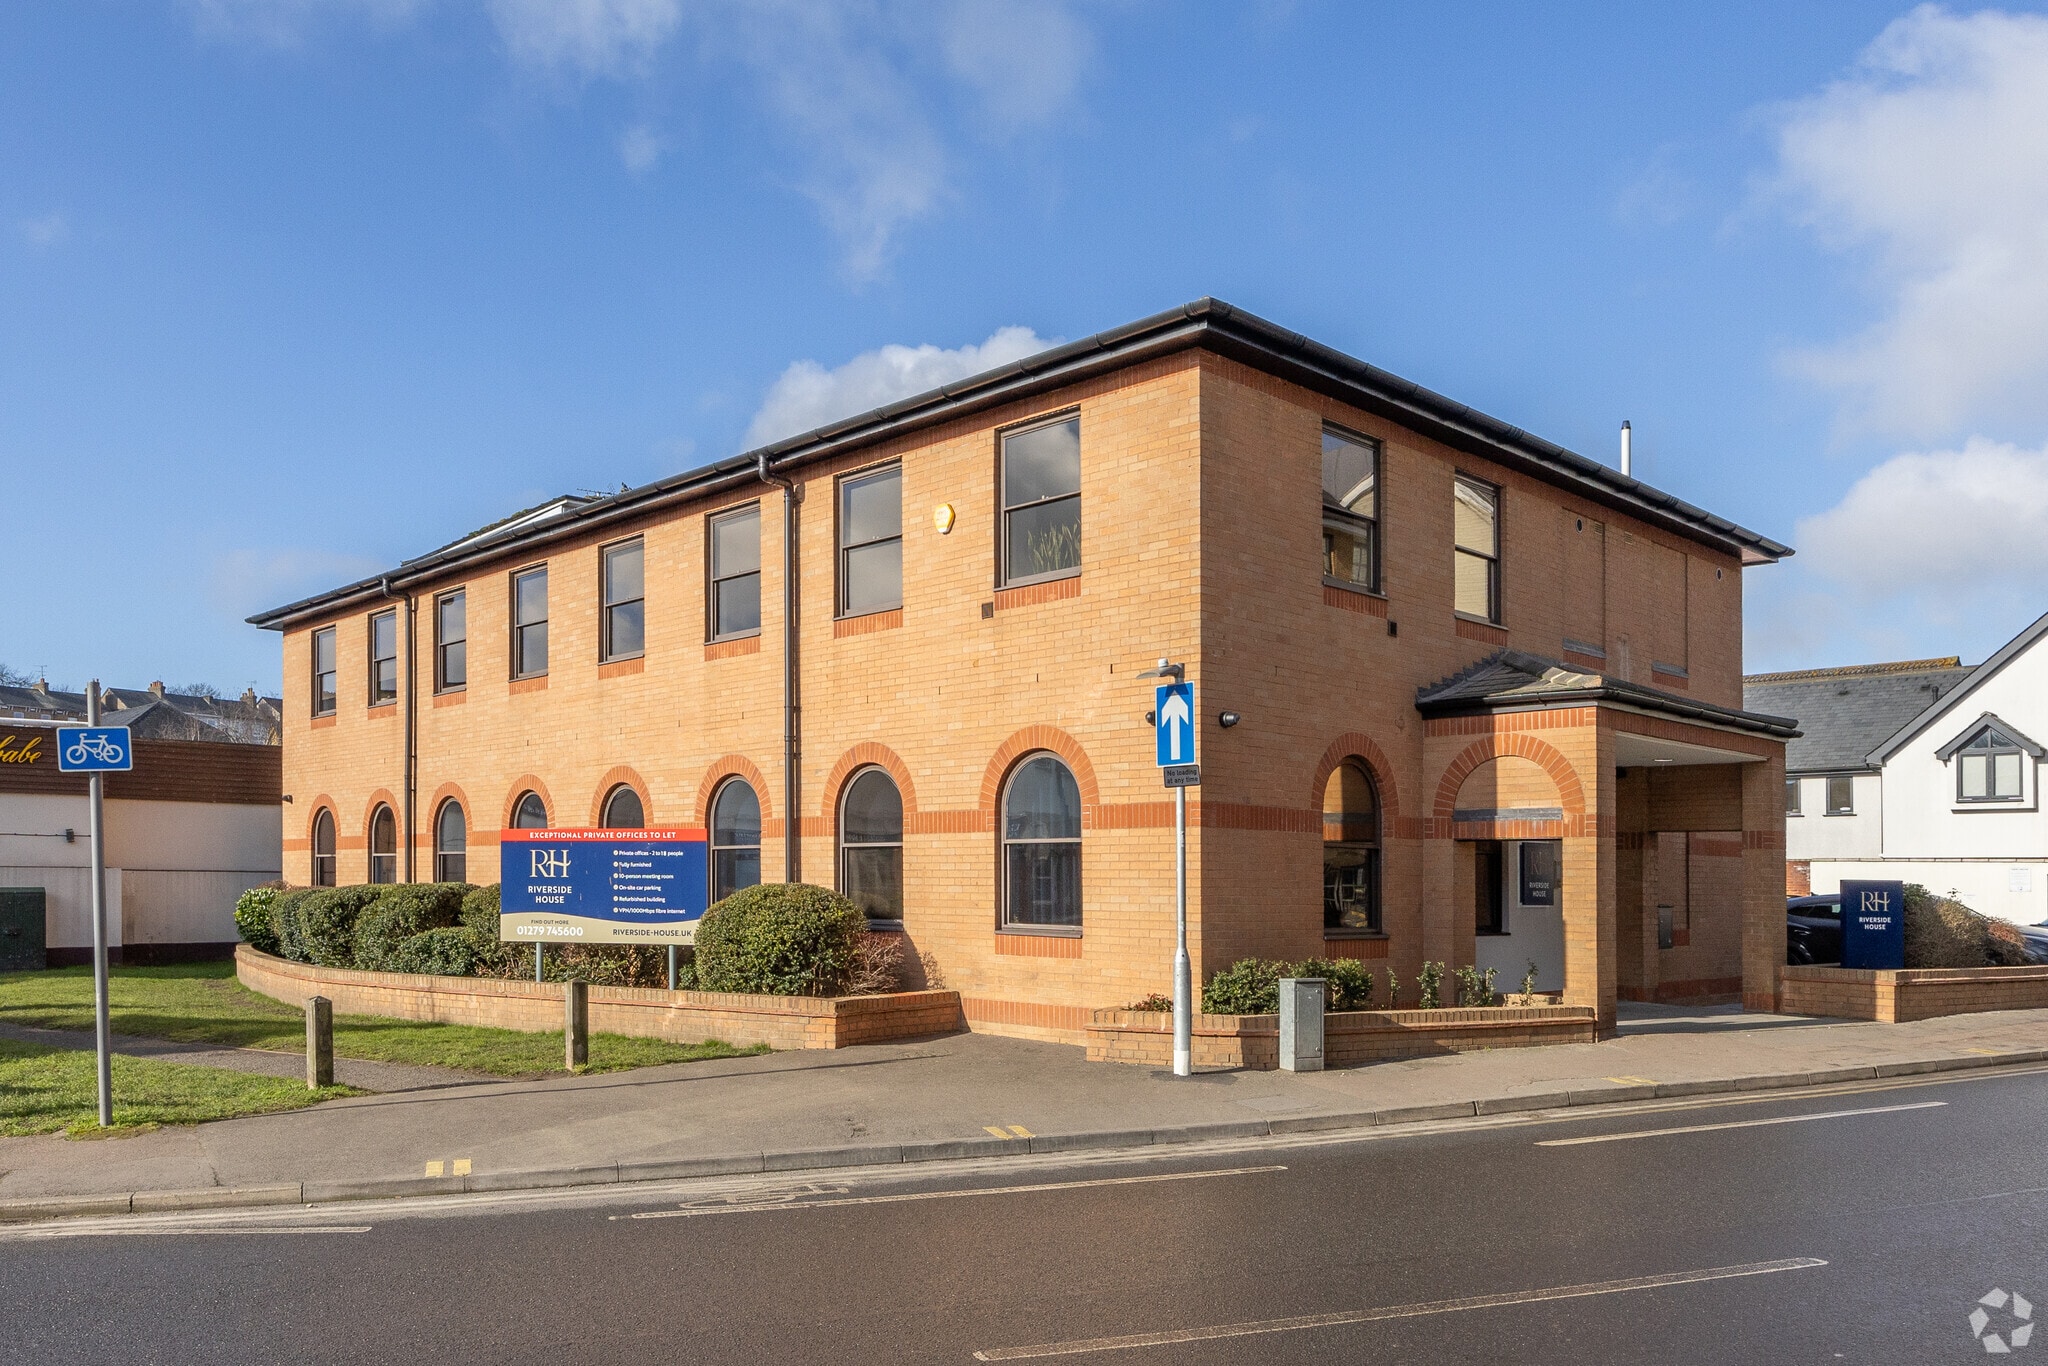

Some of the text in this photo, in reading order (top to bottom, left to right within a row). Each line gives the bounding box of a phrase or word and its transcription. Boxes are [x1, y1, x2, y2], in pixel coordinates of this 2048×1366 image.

[529, 850, 572, 878] RH
[1861, 891, 1890, 911] RH
[517, 926, 583, 937] 01279 745600
